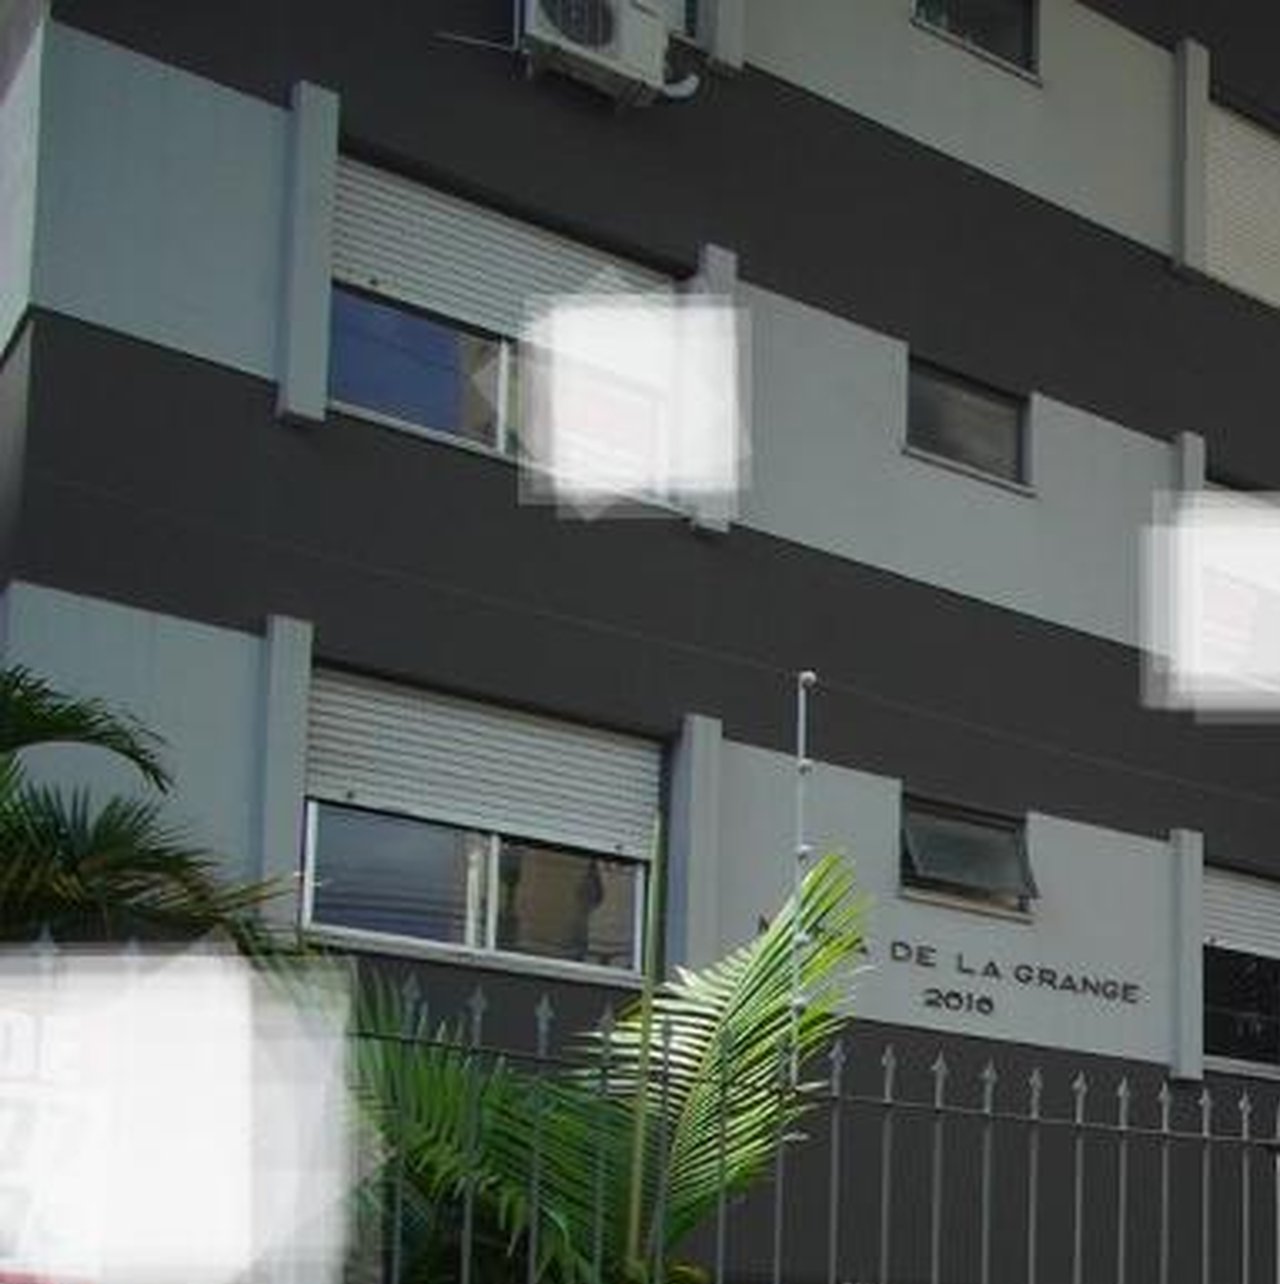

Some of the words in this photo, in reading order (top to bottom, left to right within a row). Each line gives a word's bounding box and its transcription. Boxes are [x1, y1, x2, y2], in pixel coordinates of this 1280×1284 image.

[890, 941, 937, 968] DE
[957, 953, 1002, 980] LA
[1013, 964, 1141, 1004] GRANGE
